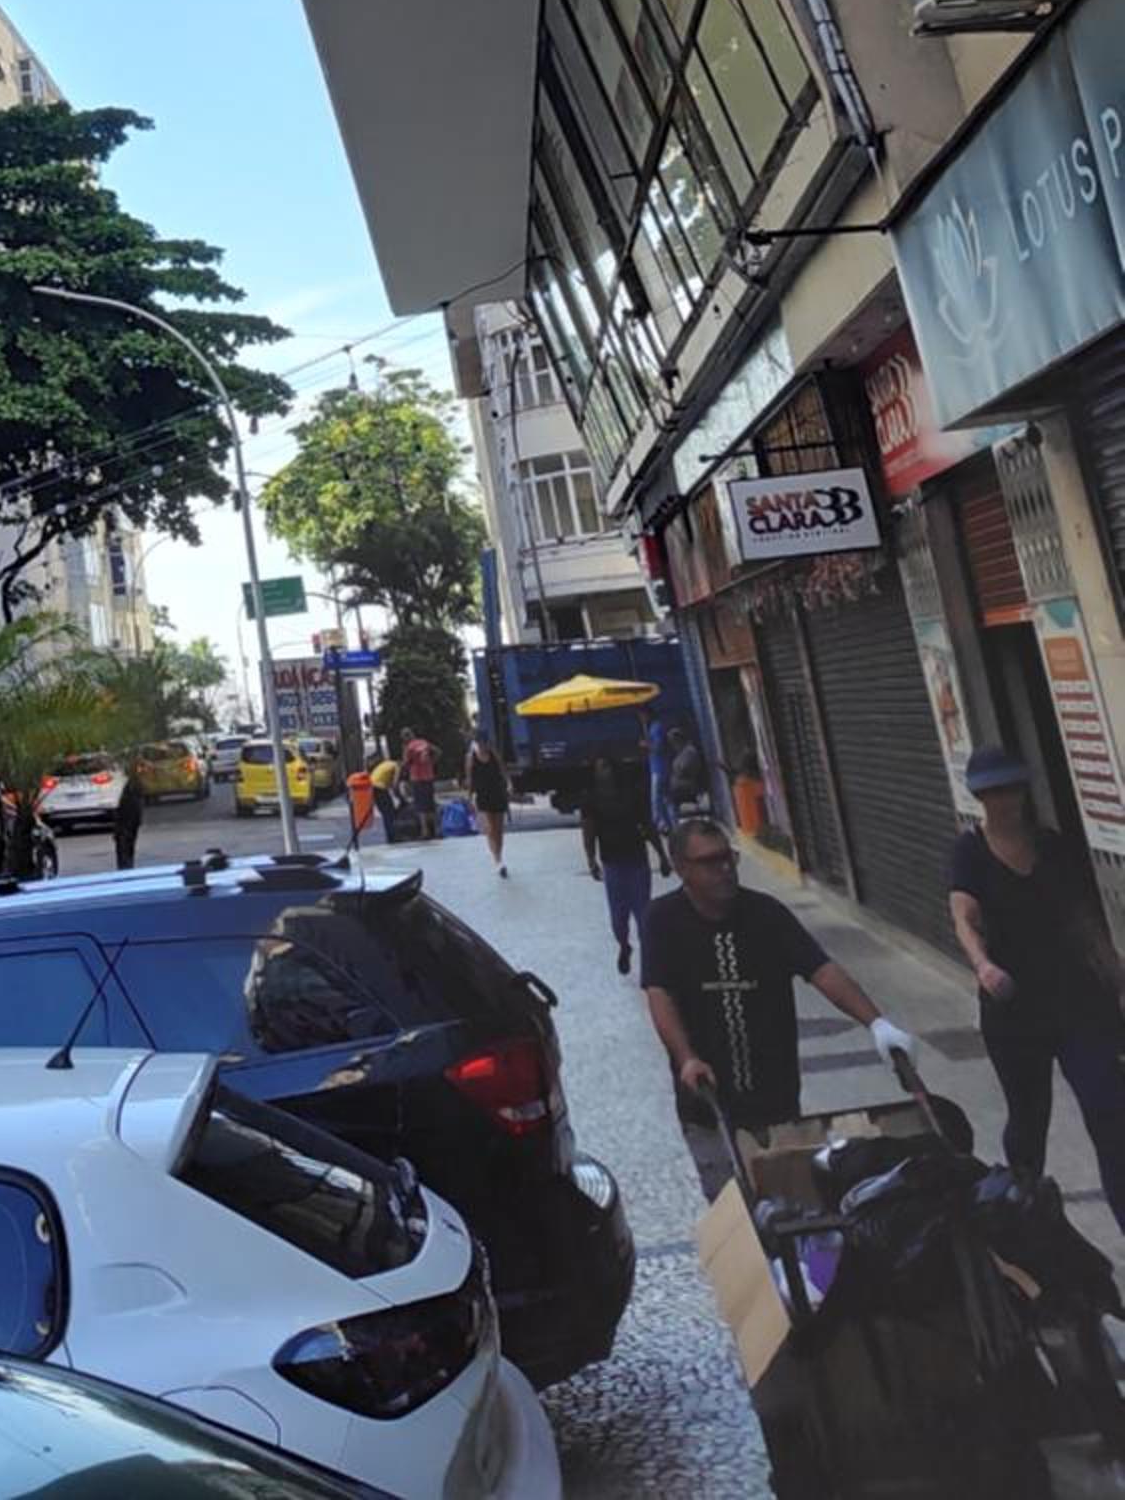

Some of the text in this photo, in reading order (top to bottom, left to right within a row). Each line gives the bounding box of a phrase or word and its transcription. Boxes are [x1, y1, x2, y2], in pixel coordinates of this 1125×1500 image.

[1004, 138, 1097, 262] LOTUS
[746, 490, 821, 517] SANTA
[749, 510, 825, 535] CLARA
